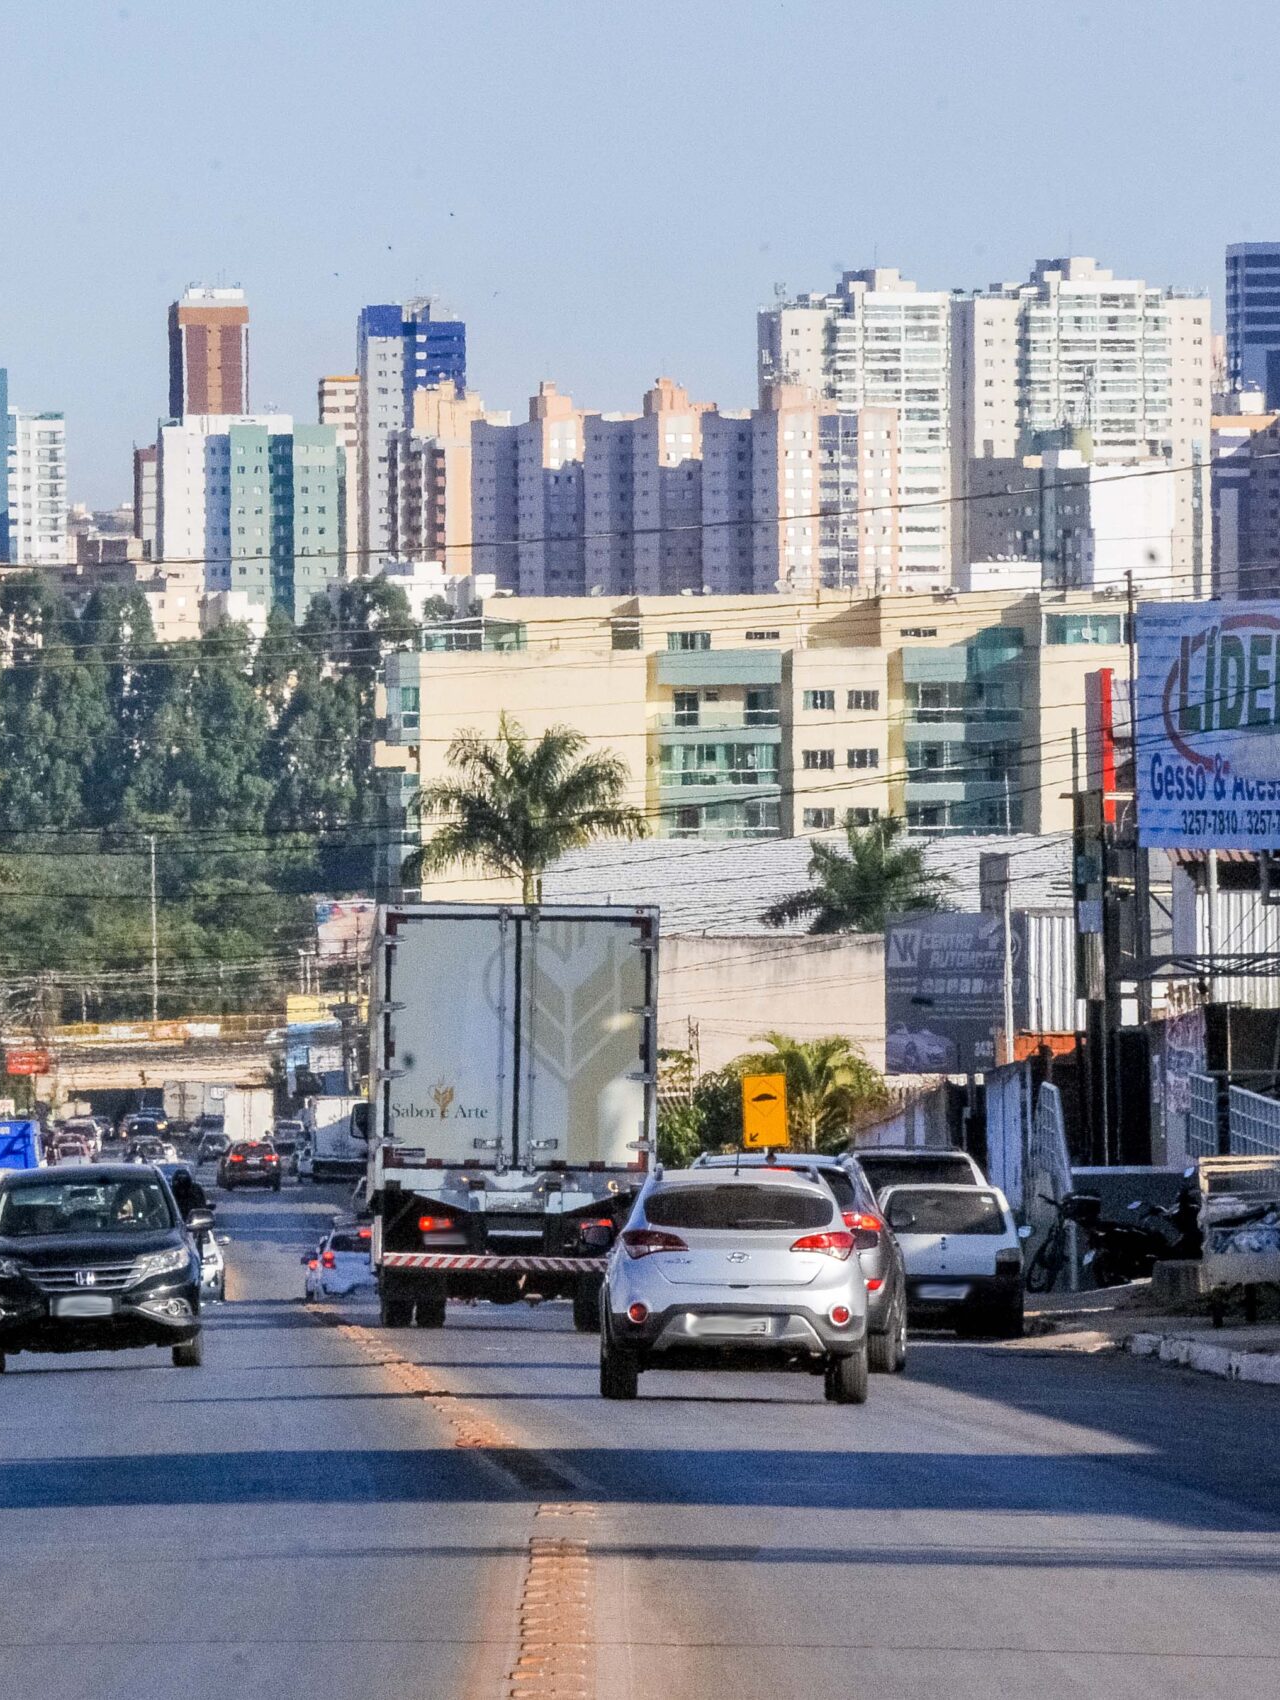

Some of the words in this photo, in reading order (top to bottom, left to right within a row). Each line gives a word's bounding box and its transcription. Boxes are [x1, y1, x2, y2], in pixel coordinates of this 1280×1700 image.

[1178, 625, 1280, 732] LÍDE
[1151, 752, 1206, 801] Gesso
[1214, 752, 1227, 801] &
[1181, 809, 1238, 835] 3257-7810
[391, 1103, 437, 1119] Sabor
[454, 1104, 489, 1119] Arte
